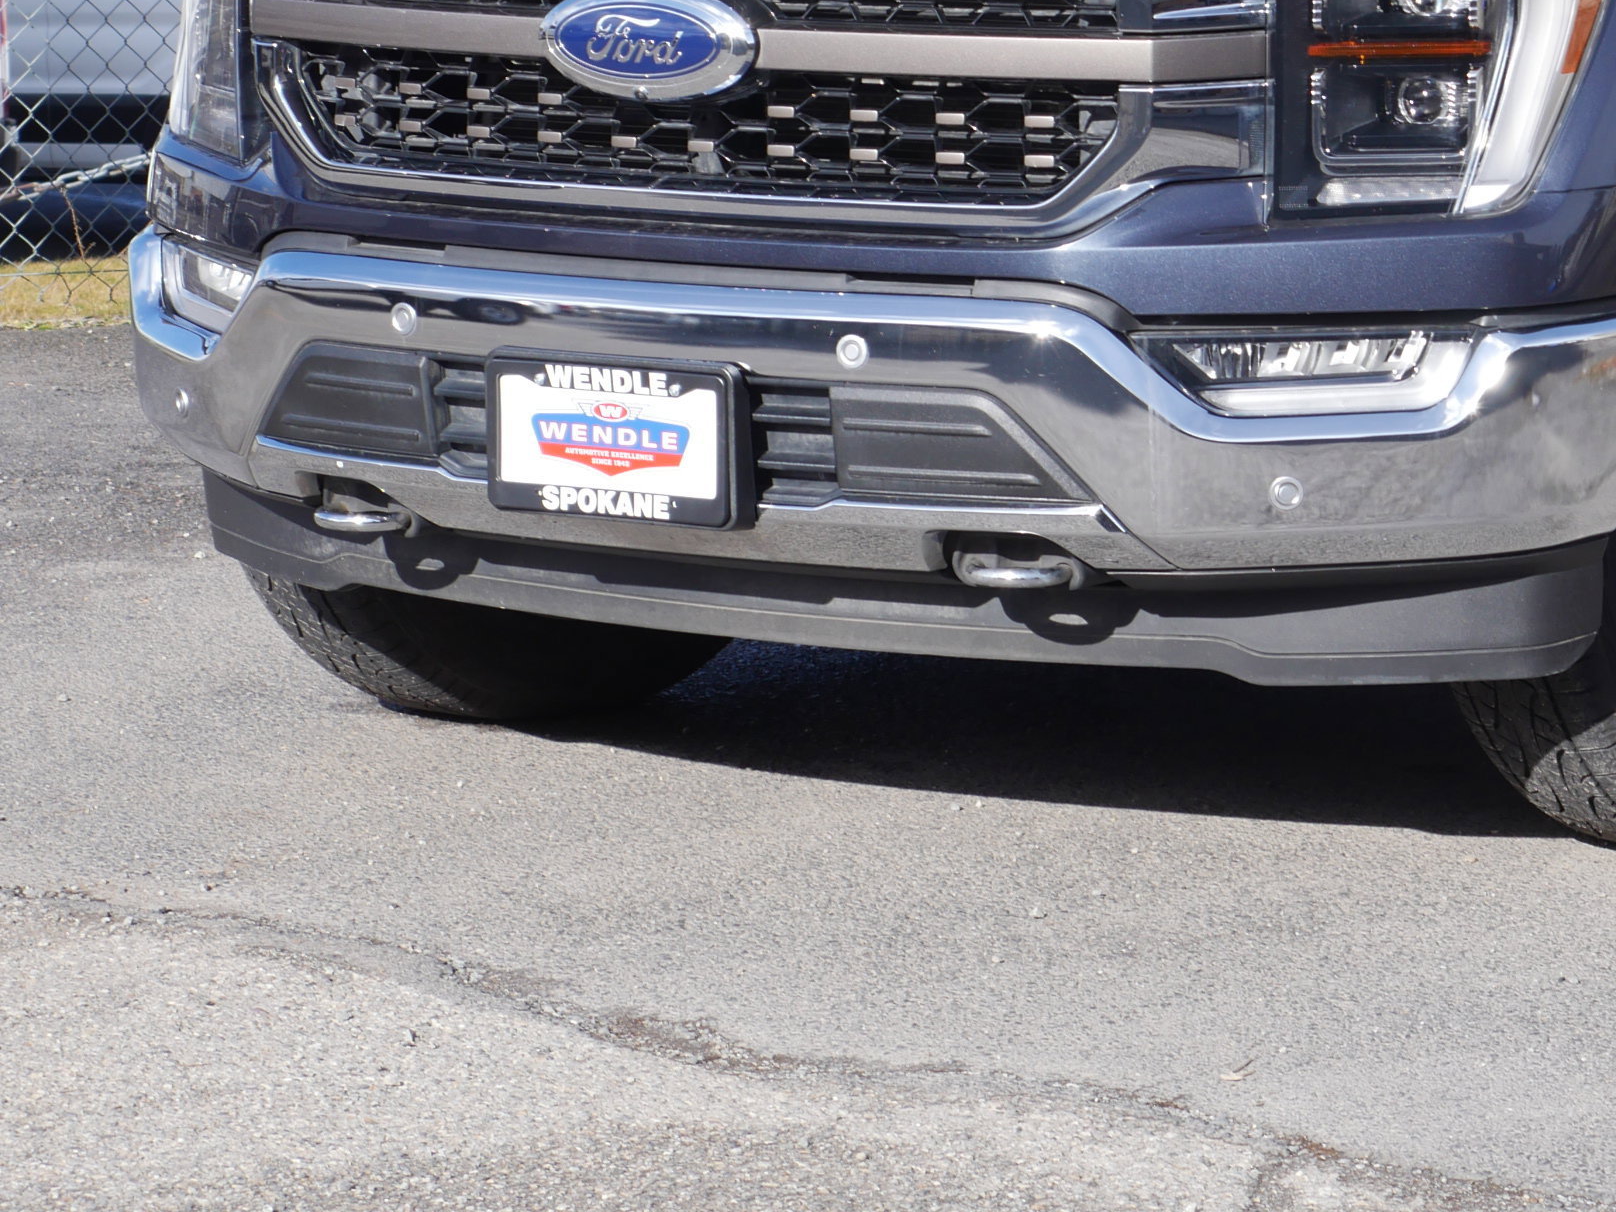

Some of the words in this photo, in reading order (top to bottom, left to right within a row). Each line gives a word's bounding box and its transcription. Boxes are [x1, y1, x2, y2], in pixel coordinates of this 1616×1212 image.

[586, 14, 684, 65] Ford
[544, 364, 669, 397] WENDLE
[538, 420, 679, 450] WENDLE
[565, 447, 610, 458] AUTOMOTIVE
[541, 485, 670, 520] SPOKANE
